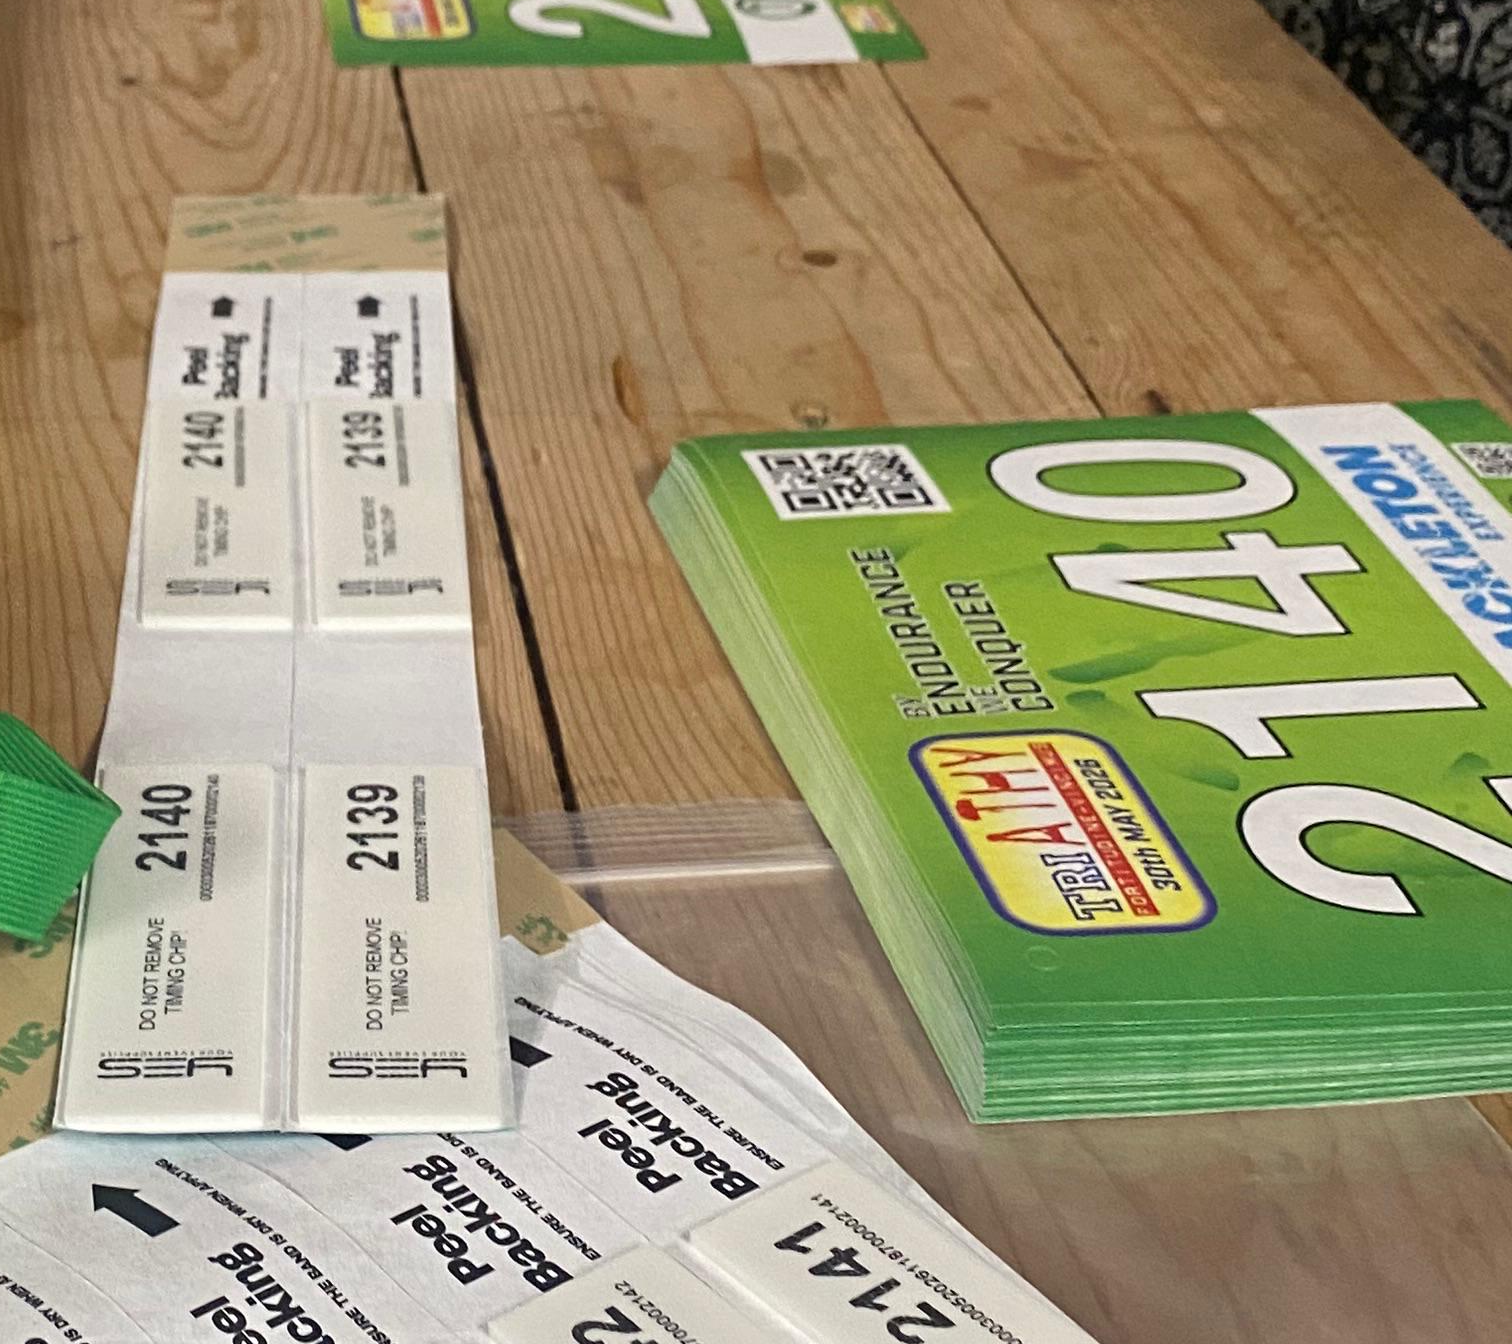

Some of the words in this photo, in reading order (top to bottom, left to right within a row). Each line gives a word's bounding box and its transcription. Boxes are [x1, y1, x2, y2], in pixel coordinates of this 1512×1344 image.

[182, 348, 207, 384] Peel
[335, 348, 358, 385] Peel
[182, 413, 223, 466] 2140
[343, 412, 385, 466] 2139
[853, 547, 975, 717] ENDURANCE
[944, 581, 1055, 715] CONQUER
[986, 437, 1512, 917] 2140
[1074, 758, 1124, 802] 2026
[135, 784, 191, 870] 2140
[346, 784, 398, 870] 2139
[1110, 802, 1147, 843] MAY
[1134, 839, 1182, 891] 30th
[144, 918, 163, 972] REMOVE
[366, 918, 381, 971] REMOVE
[142, 976, 158, 1004] NOT
[164, 968, 184, 1014] TIMING
[366, 976, 381, 1004] NOT
[390, 969, 408, 1015] TIMING
[139, 1009, 155, 1029] DO
[366, 1009, 382, 1029] DO
[573, 1026, 613, 1047] WHEN
[612, 1048, 642, 1065] DRY
[640, 1064, 658, 1075] IS
[656, 1075, 697, 1104] BAND
[585, 1072, 759, 1199] Backing
[693, 1104, 724, 1128] THE
[577, 1118, 682, 1192] Peel
[723, 1127, 784, 1169] ENSURE
[207, 1190, 246, 1215] WHEN
[402, 1155, 573, 1292] Backing
[243, 1216, 272, 1233] DRY
[269, 1233, 286, 1244] IS
[390, 1203, 494, 1284] Peel
[283, 1245, 322, 1279] BAND
[774, 1221, 955, 1344] 2141
[318, 1279, 348, 1307] THE
